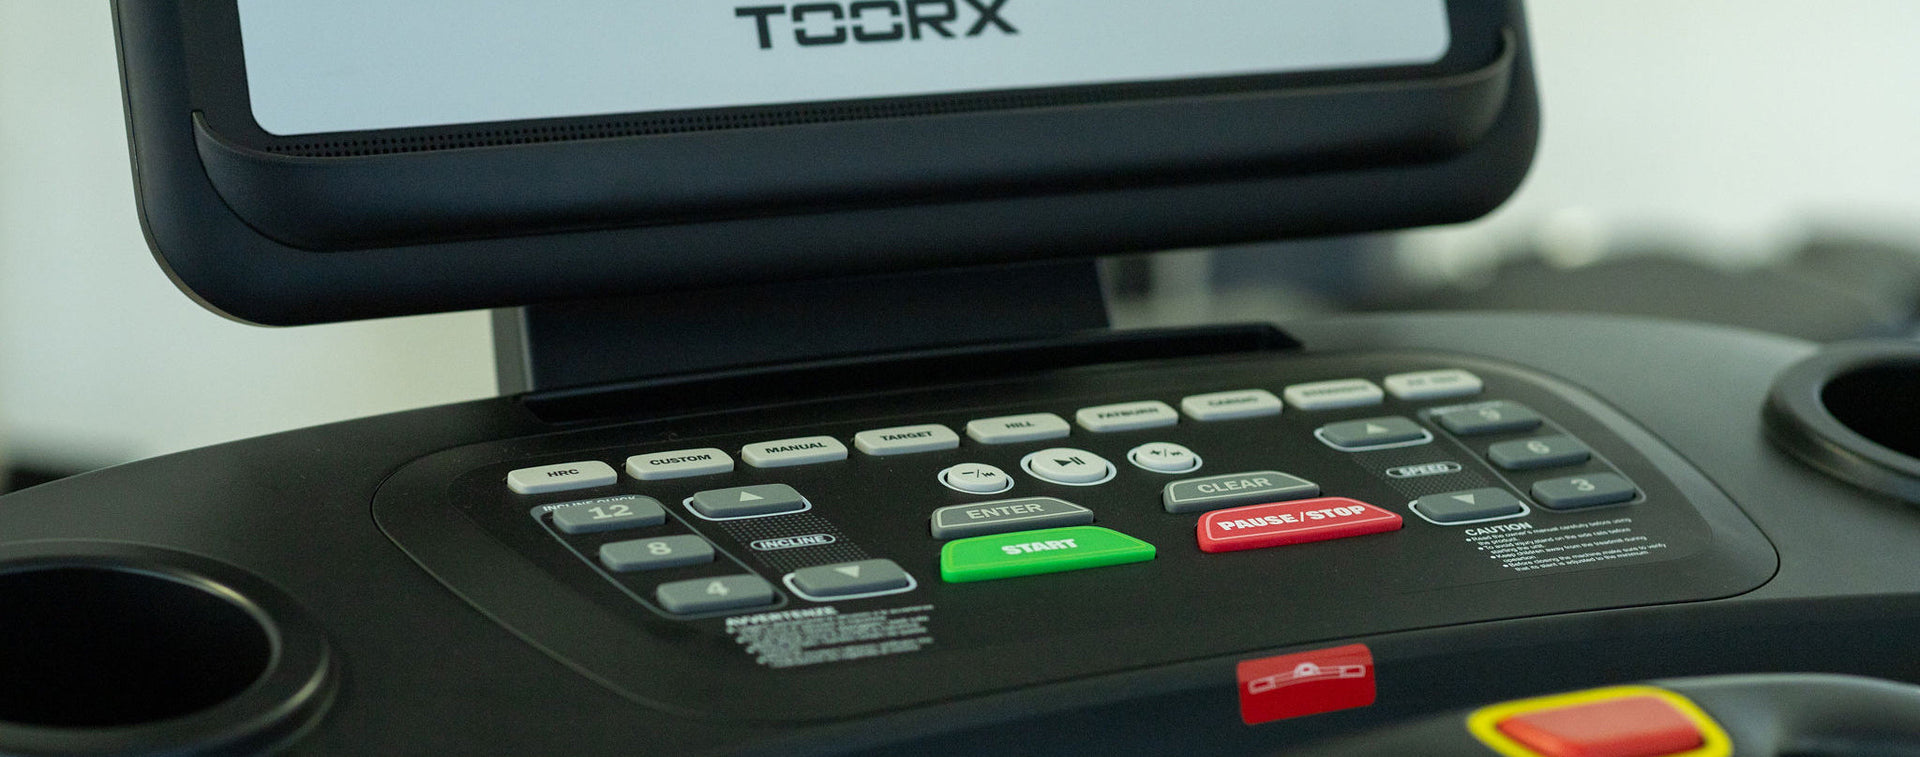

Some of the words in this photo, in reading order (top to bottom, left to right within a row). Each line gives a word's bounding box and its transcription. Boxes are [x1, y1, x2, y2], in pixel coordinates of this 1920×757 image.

[735, 0, 1020, 50] TOORX
[1005, 420, 1035, 430] HILL
[880, 430, 933, 442] TARGET
[765, 441, 828, 454] MANUAL
[1527, 440, 1550, 454] 6
[649, 453, 712, 466] CUSTOM
[547, 469, 579, 478] HRC
[1399, 464, 1449, 476] SPEED
[1196, 476, 1271, 495] CLEAR
[1570, 478, 1596, 492] 3
[588, 504, 634, 519] 12
[966, 501, 1044, 520] ENTER
[1217, 505, 1366, 532] PAUSE/STOP
[1465, 522, 1533, 536] CAUTION
[647, 541, 672, 555] 8
[760, 535, 827, 549] INCLINE
[1001, 538, 1077, 555] START
[706, 580, 731, 597] 4
